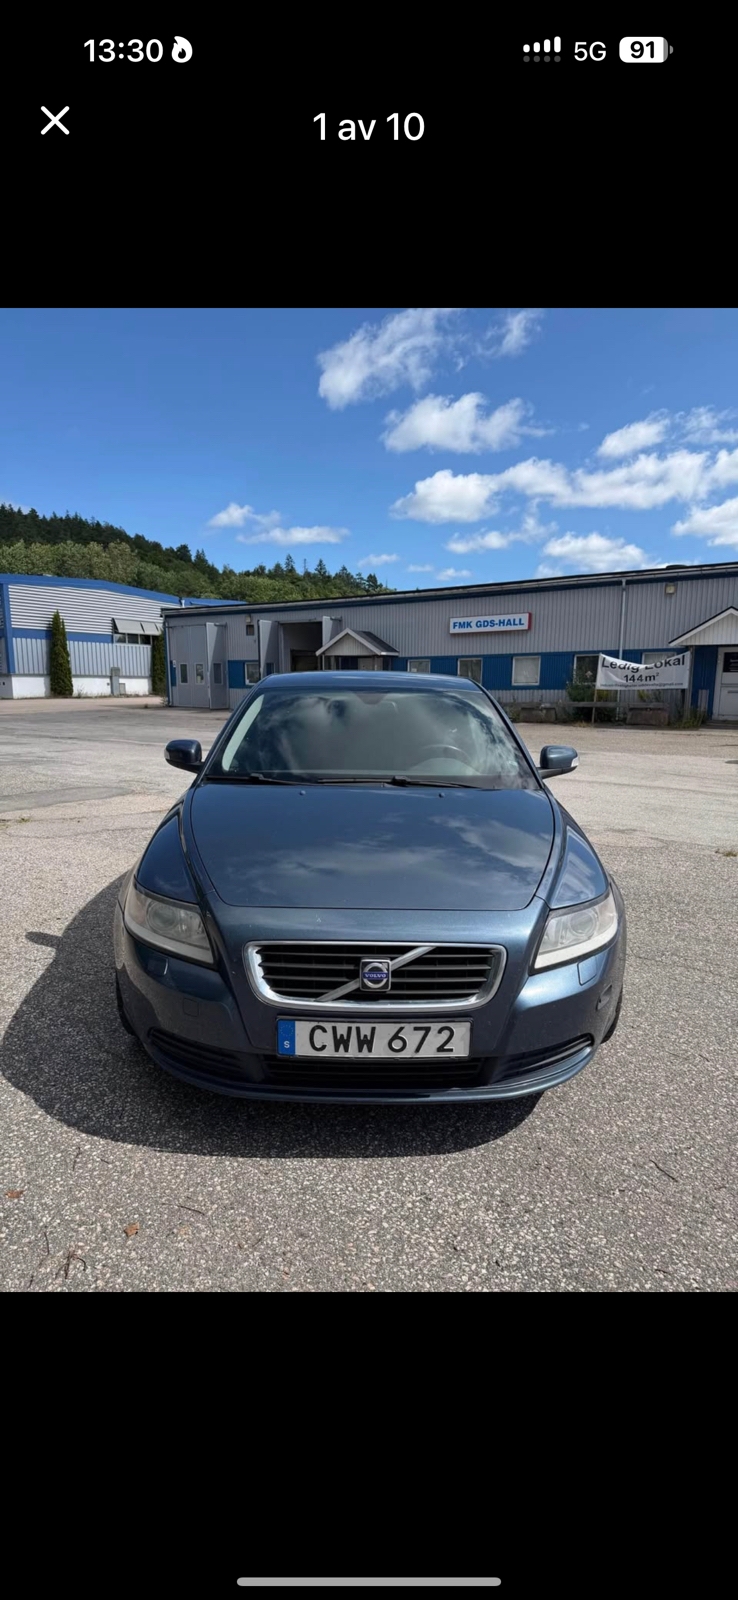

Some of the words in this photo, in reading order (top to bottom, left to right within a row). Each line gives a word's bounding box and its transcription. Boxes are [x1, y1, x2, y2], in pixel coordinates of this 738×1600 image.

[452, 620, 473, 630] FMK
[476, 617, 525, 629] GDS-HALL
[602, 657, 640, 674] Ledig
[283, 1041, 290, 1049] S
[309, 1024, 376, 1053] CWW
[387, 1025, 455, 1054] 672
